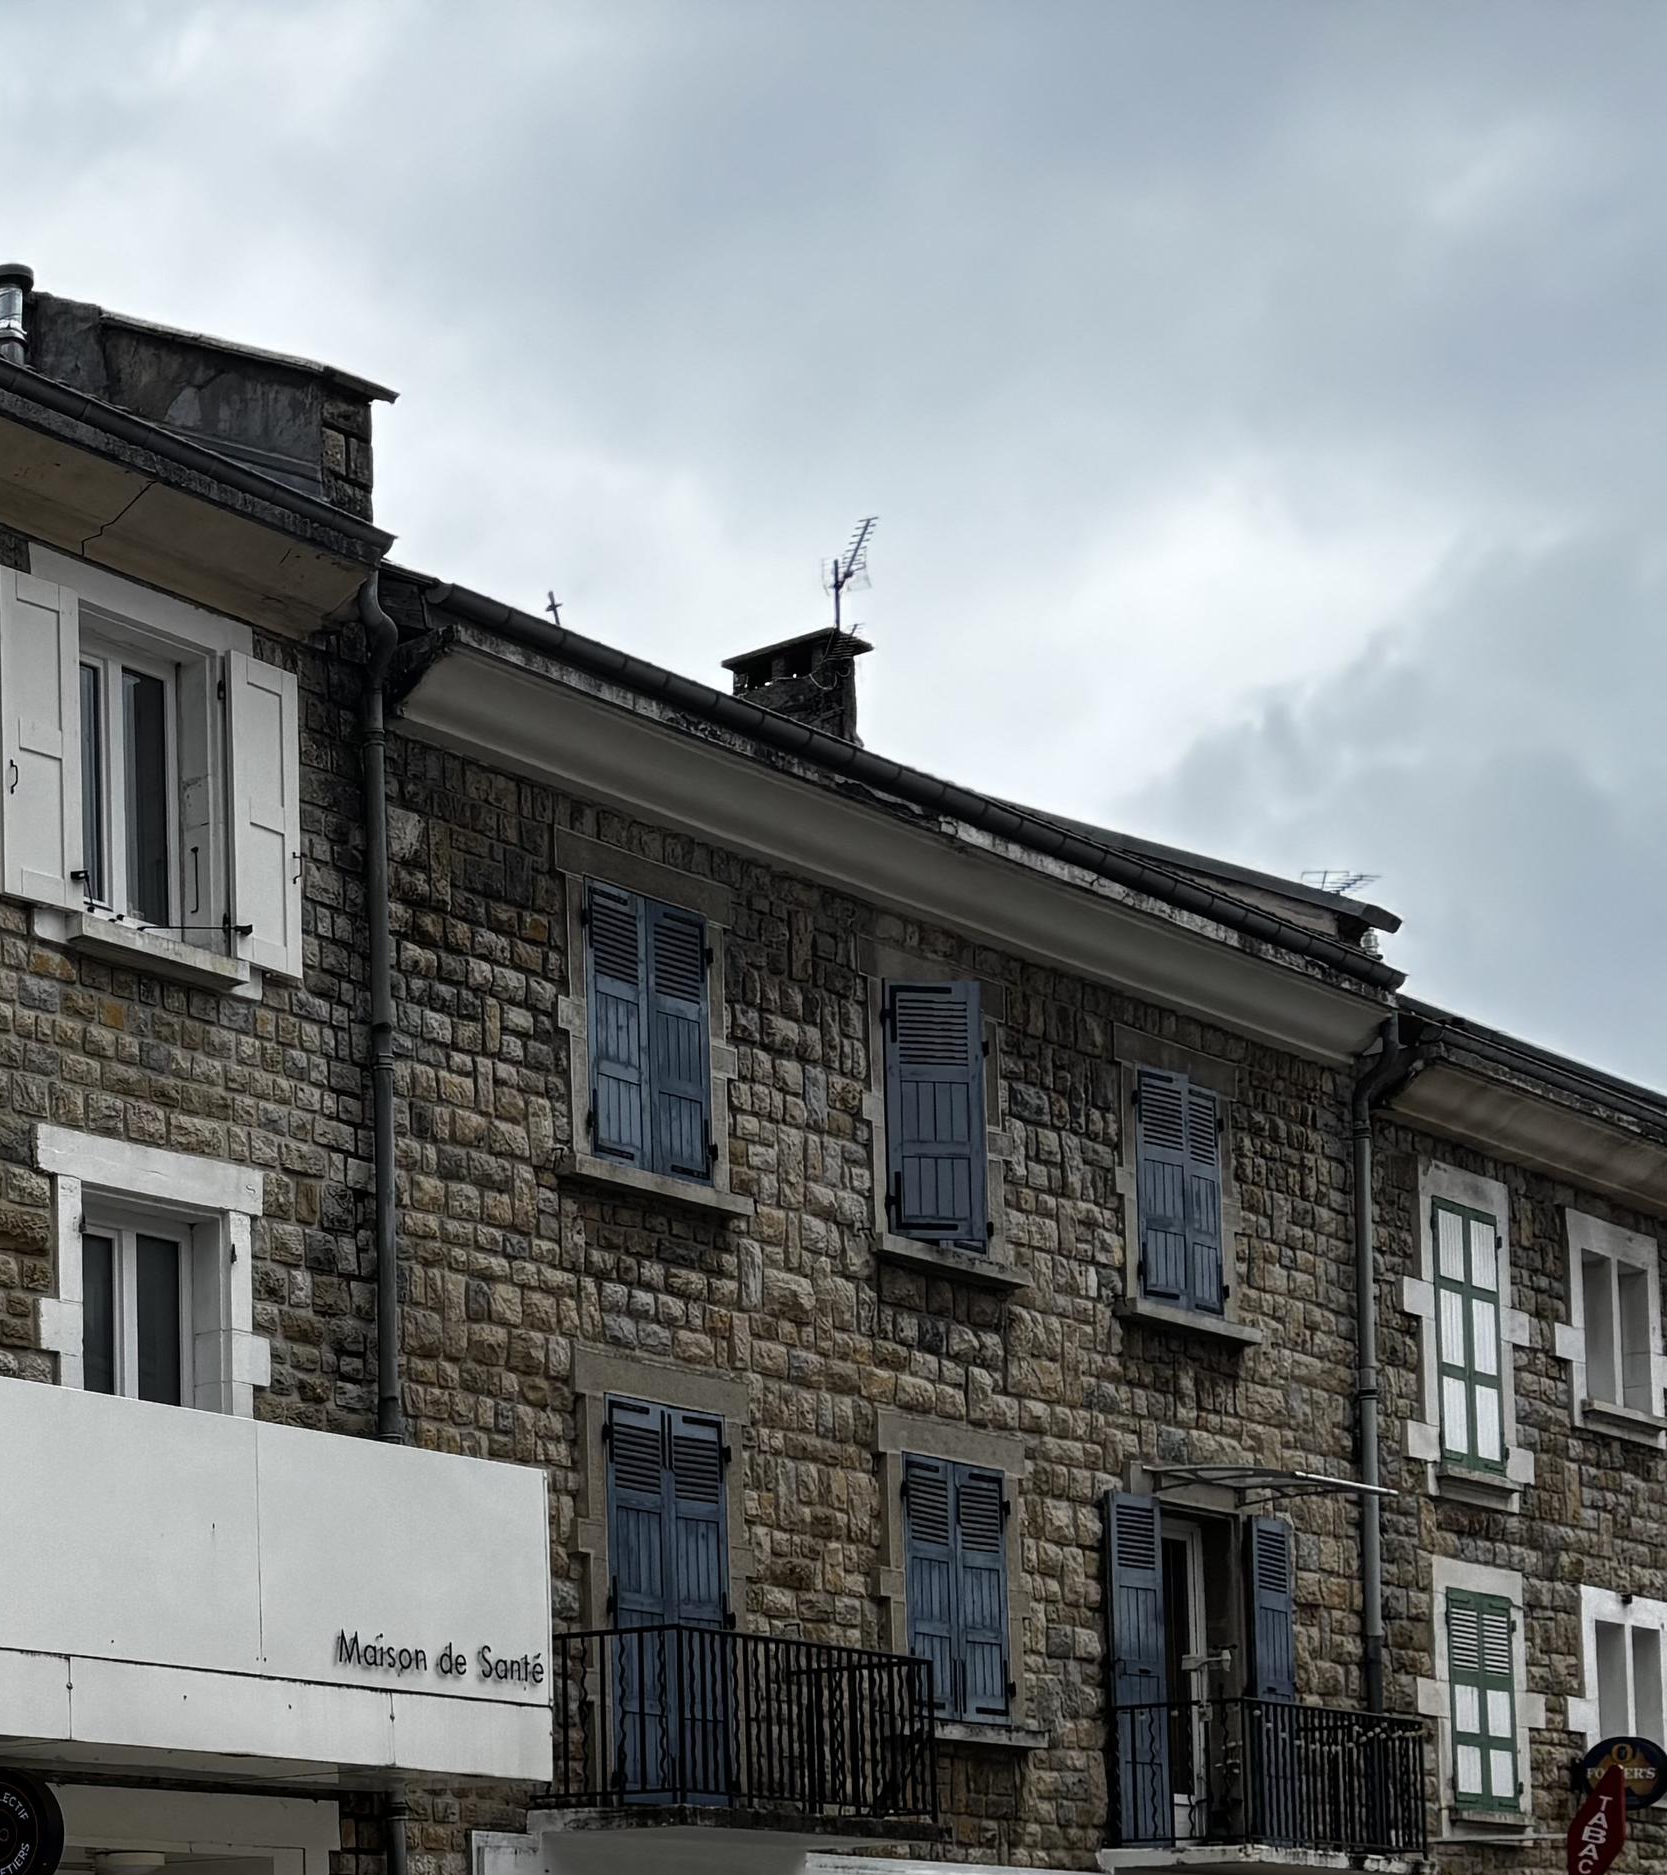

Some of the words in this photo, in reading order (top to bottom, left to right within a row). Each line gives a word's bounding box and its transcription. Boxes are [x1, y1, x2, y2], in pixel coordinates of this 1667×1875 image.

[338, 1628, 427, 1672] Maison
[439, 1641, 467, 1675] de
[481, 1644, 545, 1683] Santé
[1578, 1795, 1613, 1875] TABAC
